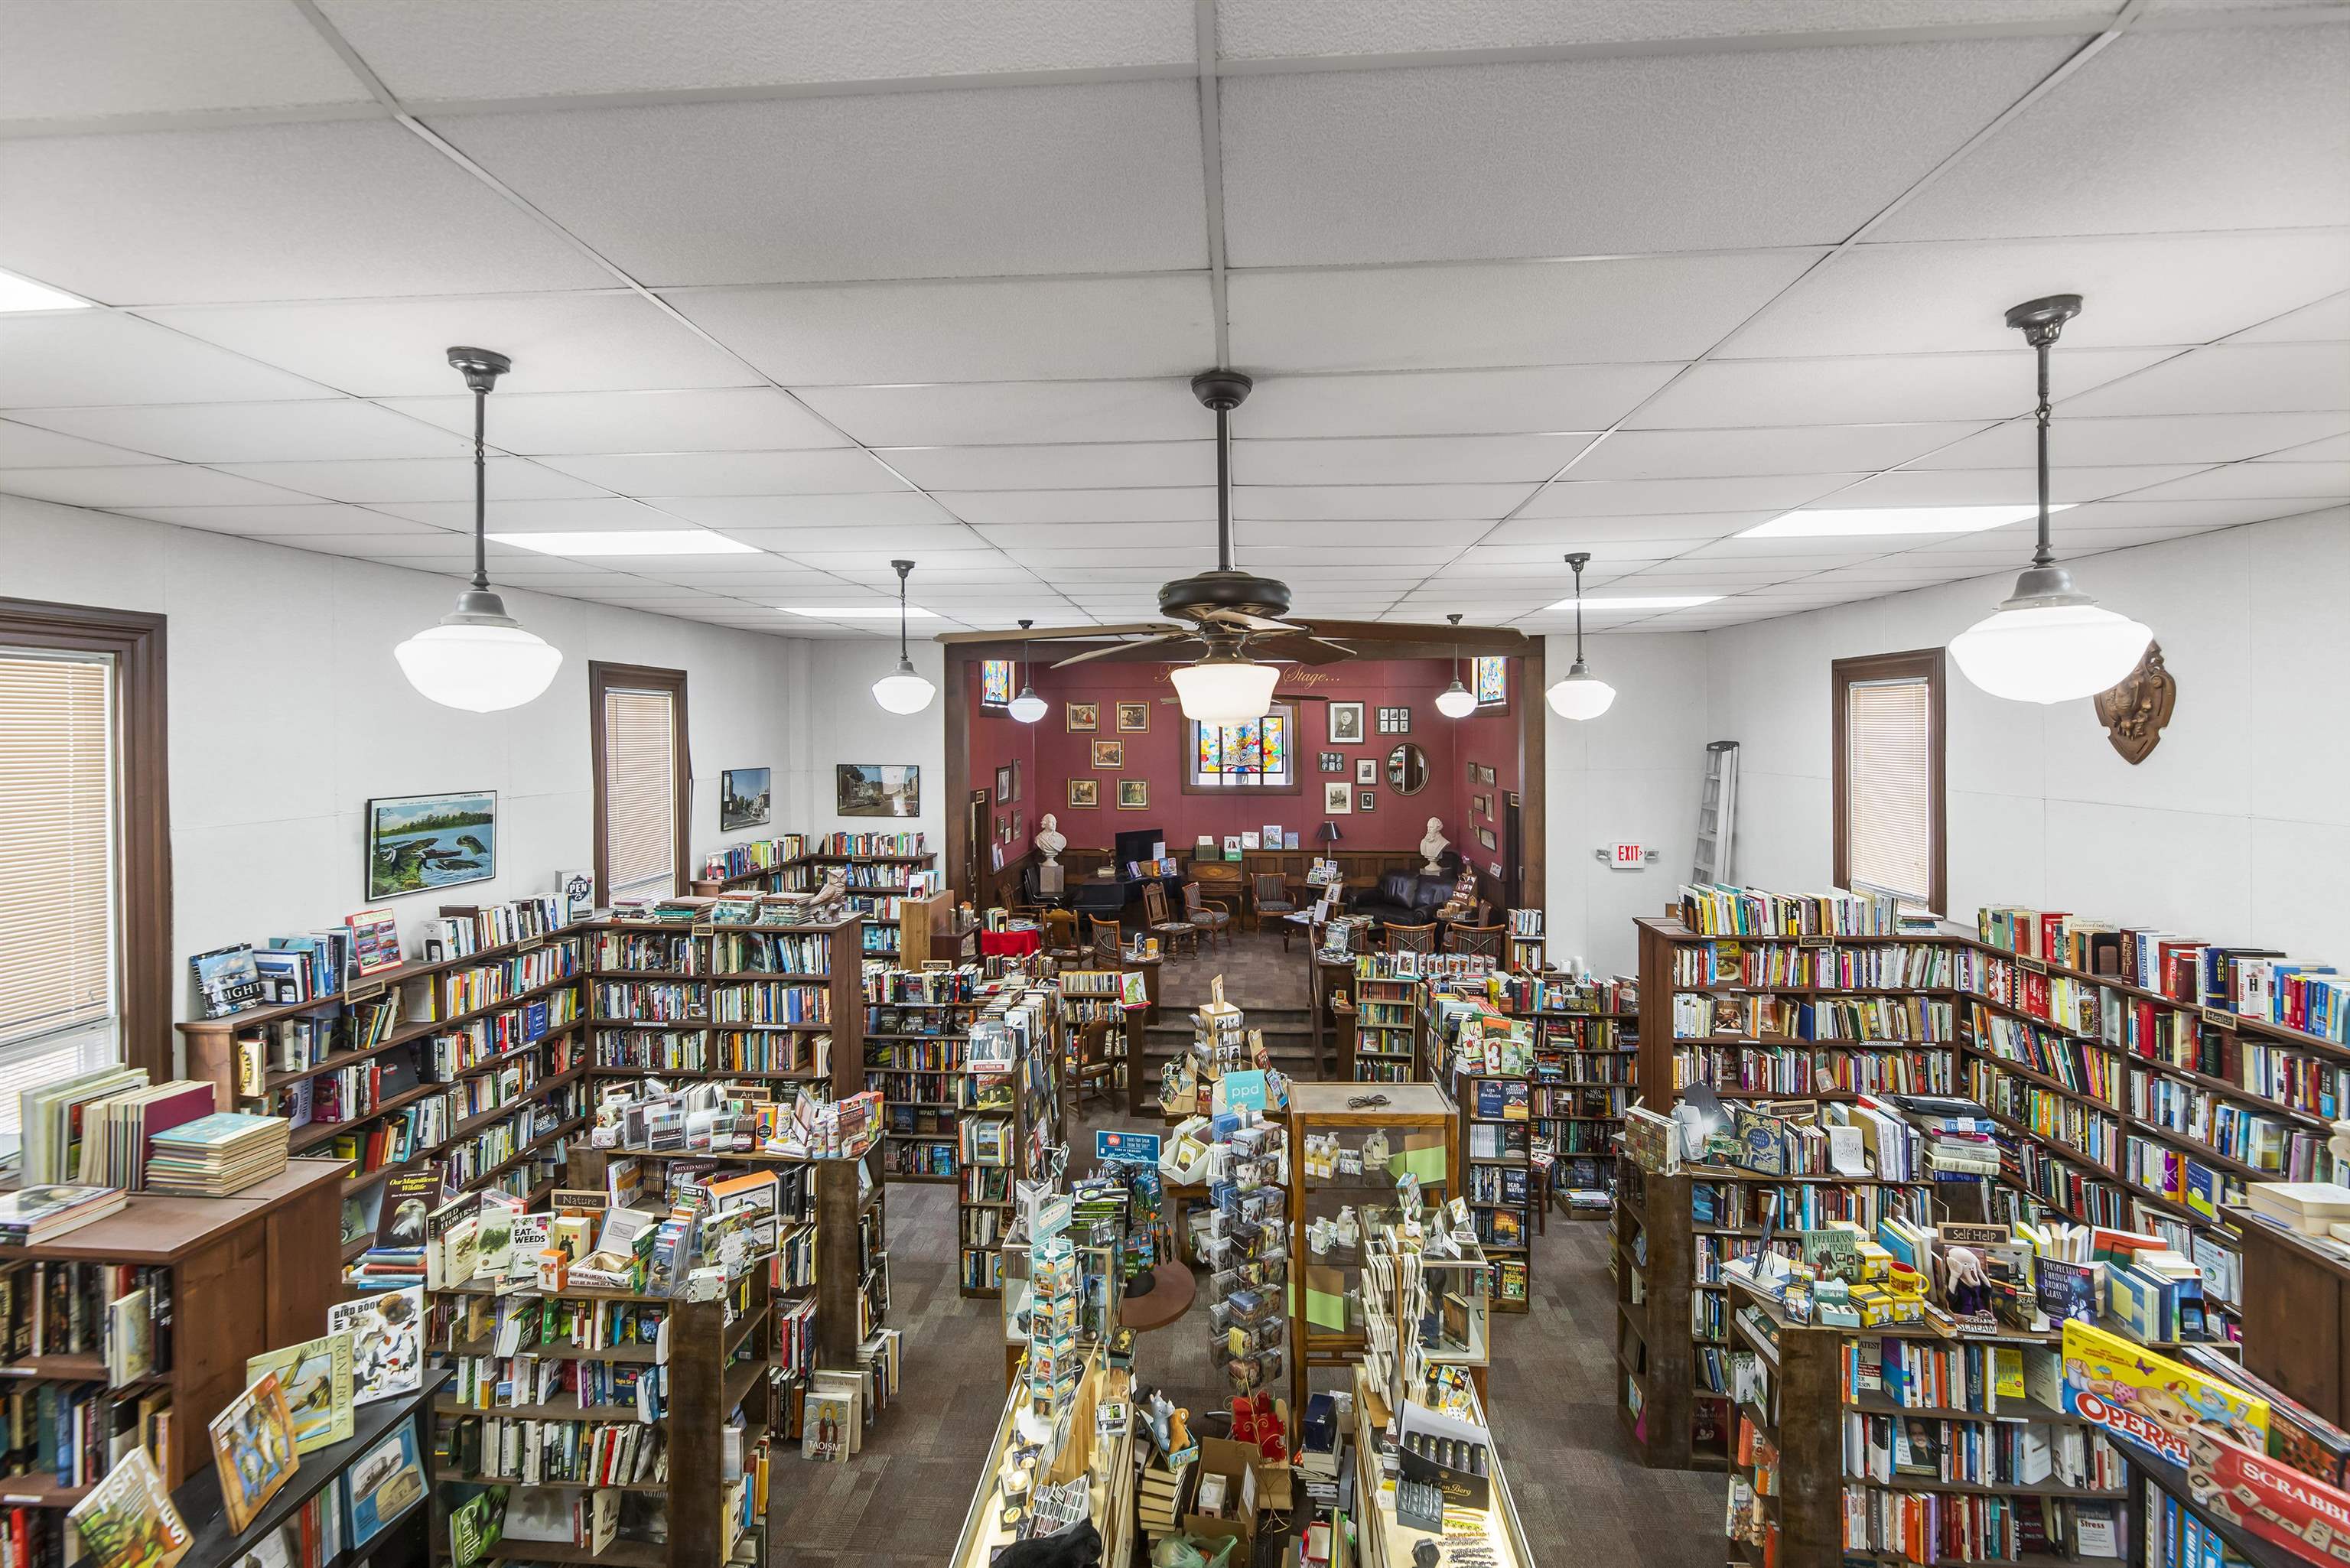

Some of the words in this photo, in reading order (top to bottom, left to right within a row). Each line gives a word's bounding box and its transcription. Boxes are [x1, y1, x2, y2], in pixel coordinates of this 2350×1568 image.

[1618, 845, 1639, 861] EXIT
[569, 883, 588, 893] PEN
[2020, 959, 2042, 971] Cooking
[2207, 1012, 2232, 1026] Health
[1232, 1084, 1259, 1099] ppd
[935, 1165, 949, 1174] PREY
[402, 1176, 439, 1186] Magnificent
[562, 1195, 598, 1206] Nature
[440, 1207, 459, 1222] WILD
[441, 1208, 472, 1230] FLOWERS
[514, 1228, 531, 1237] EAT
[1953, 1229, 1971, 1240] Self
[1973, 1230, 1997, 1242] Help
[514, 1235, 545, 1244] WEEDS
[1811, 1235, 1851, 1247] FREUDIAN
[1829, 1243, 1853, 1252] FINERY
[2042, 1260, 2081, 1277] PERSPECTIVES
[2043, 1269, 2072, 1284] THROUGH
[2044, 1278, 2068, 1292] BROKEN
[2045, 1289, 2062, 1300] GLASS
[334, 1306, 356, 1319] BIRD
[334, 1319, 343, 1331] MY
[1958, 1323, 1997, 1332] SCREAM
[1857, 1342, 1880, 1350] ATEST
[2076, 1392, 2189, 1462] OPERAT
[809, 1440, 841, 1452] TAOISM
[97, 1465, 138, 1514] FISH
[1450, 1484, 1472, 1497] Berg
[2243, 1461, 2350, 1524] SCRABBL
[134, 1451, 187, 1545] TALES
[2081, 1519, 2105, 1529] Stress
